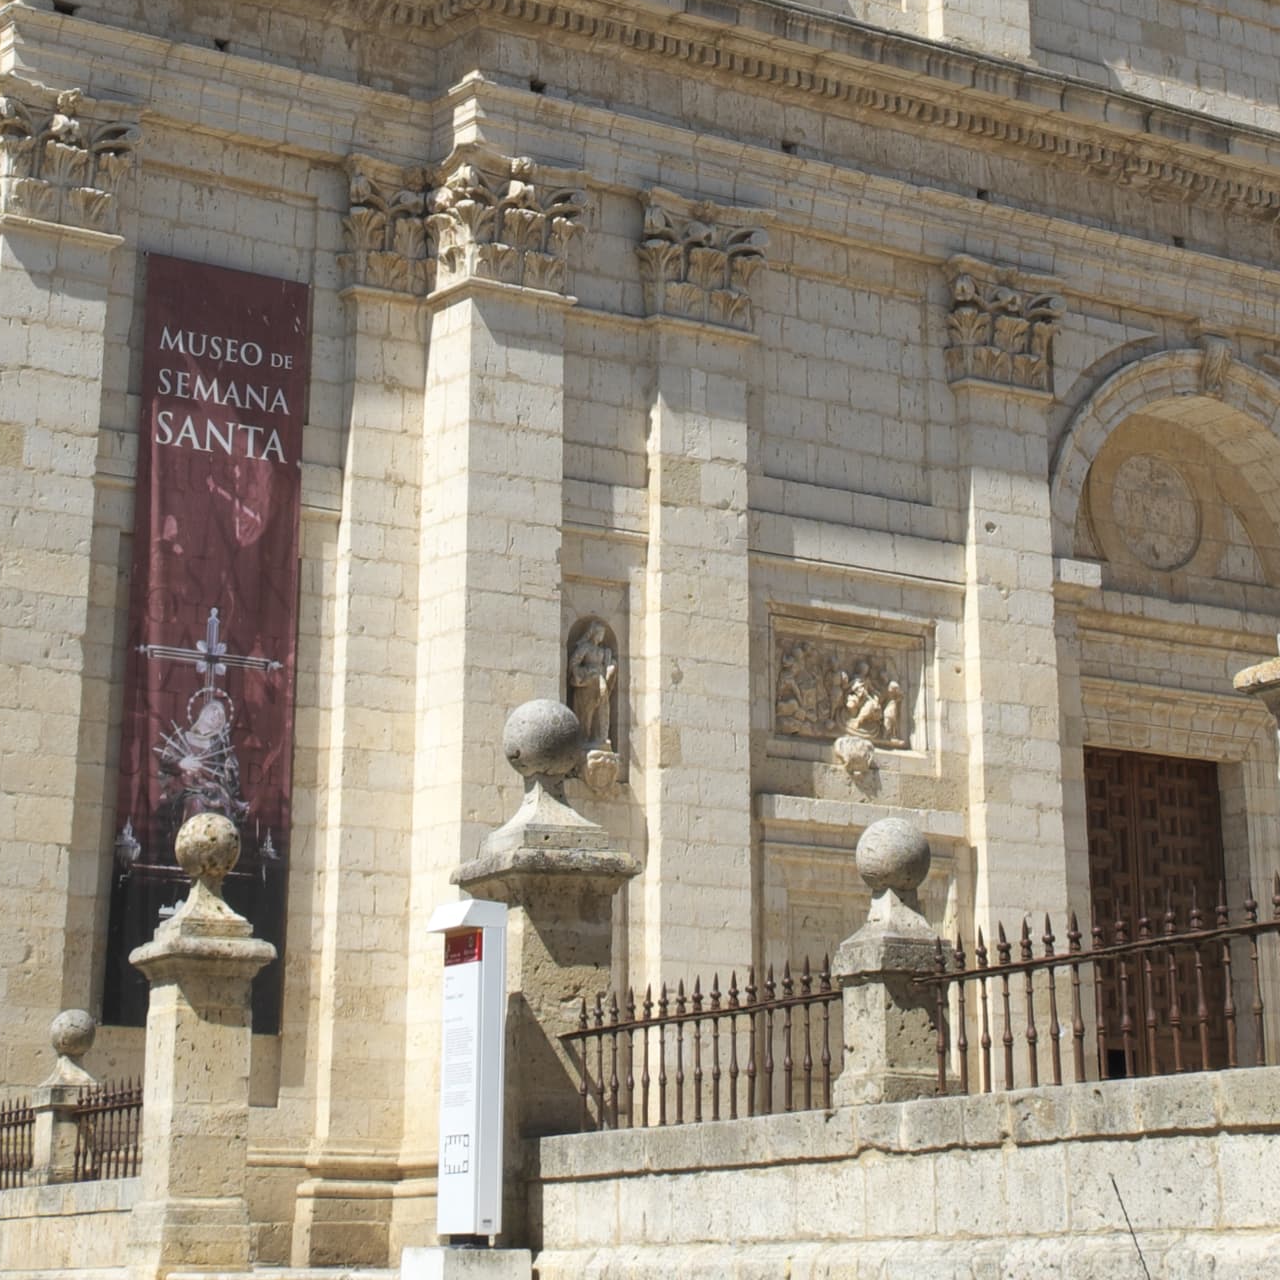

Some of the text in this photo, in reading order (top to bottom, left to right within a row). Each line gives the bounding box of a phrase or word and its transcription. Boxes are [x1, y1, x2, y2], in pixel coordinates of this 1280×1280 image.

[160, 326, 293, 369] MUSEO DE
[157, 369, 290, 415] SEMANA
[155, 411, 288, 464] SANTA
